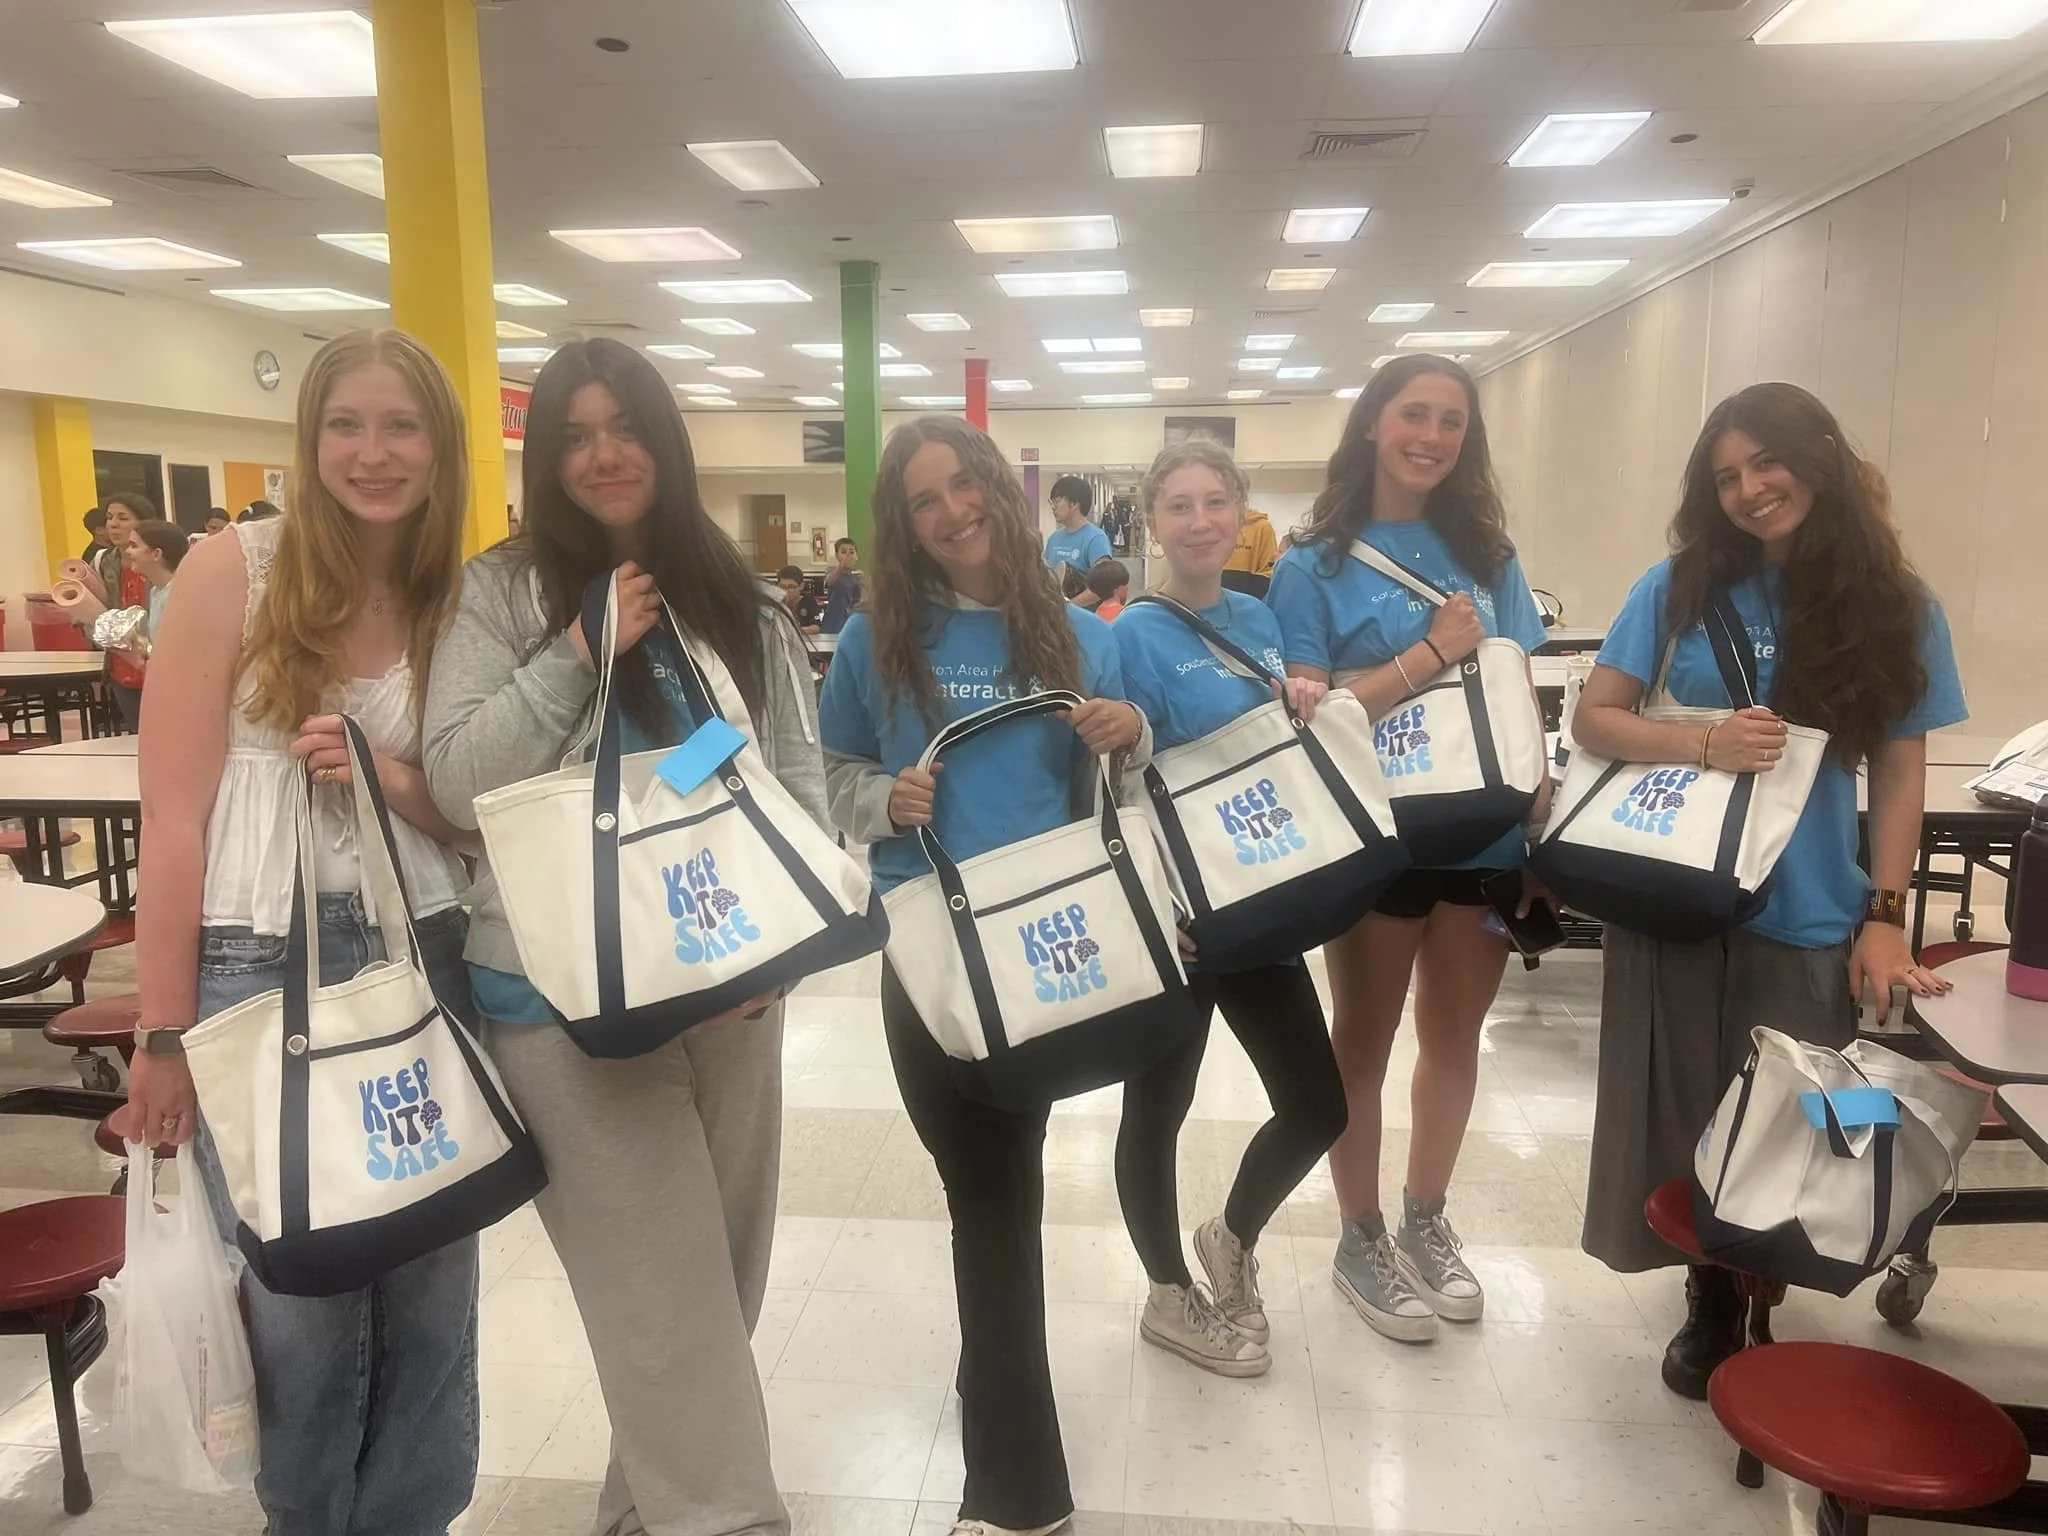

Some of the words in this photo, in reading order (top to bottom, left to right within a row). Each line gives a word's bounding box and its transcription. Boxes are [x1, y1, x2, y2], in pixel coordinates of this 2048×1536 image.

[957, 663, 988, 677] Area
[1373, 703, 1426, 751] KEEP
[1388, 731, 1408, 756] IT
[1629, 769, 1699, 796] KEEP
[1638, 788, 1668, 811] IT
[1215, 778, 1277, 836] KEEP
[1245, 812, 1272, 840] IT
[1612, 796, 1677, 836] SAFE
[1233, 822, 1306, 866] SAFE
[661, 848, 719, 919] KEEP
[675, 907, 760, 964] SAFE
[1018, 903, 1087, 967] KEEP
[1049, 940, 1076, 974] IT
[1034, 956, 1107, 1003] SAFE
[359, 1057, 430, 1134] KEEP
[387, 1104, 421, 1147] IT
[367, 1120, 459, 1181] SAFE
